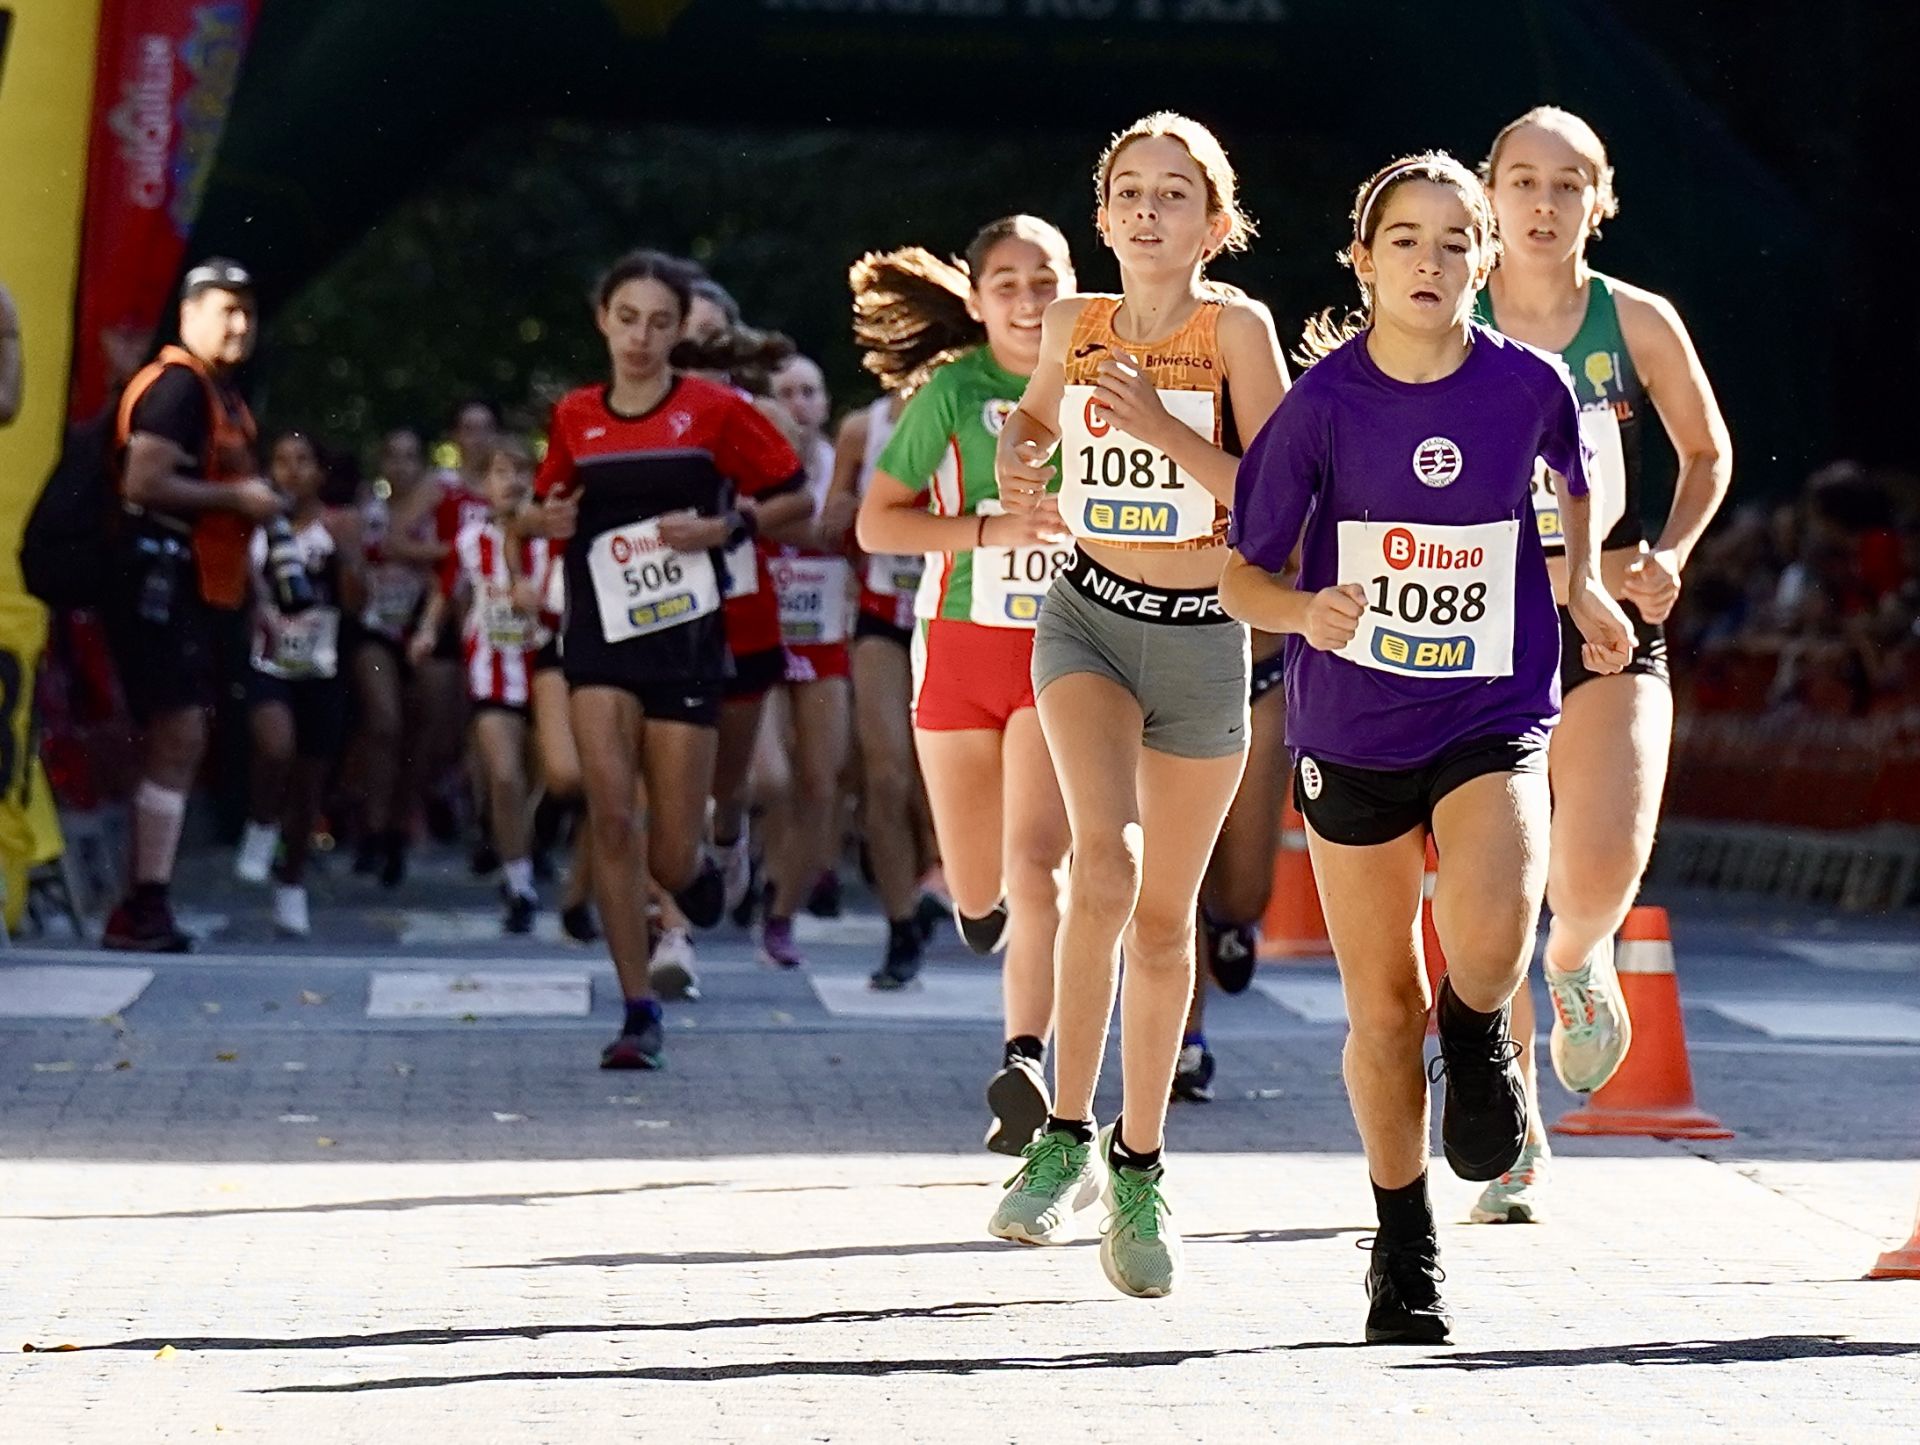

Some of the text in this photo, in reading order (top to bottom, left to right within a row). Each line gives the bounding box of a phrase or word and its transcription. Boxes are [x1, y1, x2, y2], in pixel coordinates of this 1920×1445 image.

[1145, 354, 1212, 370] Briviesca
[1079, 446, 1185, 489] 1081
[1119, 504, 1169, 532] BM
[1383, 527, 1484, 571] Bilbao
[624, 553, 683, 597] 506
[1082, 567, 1168, 617] NIKE
[1369, 575, 1487, 626] 1088
[1414, 640, 1467, 667] BM
